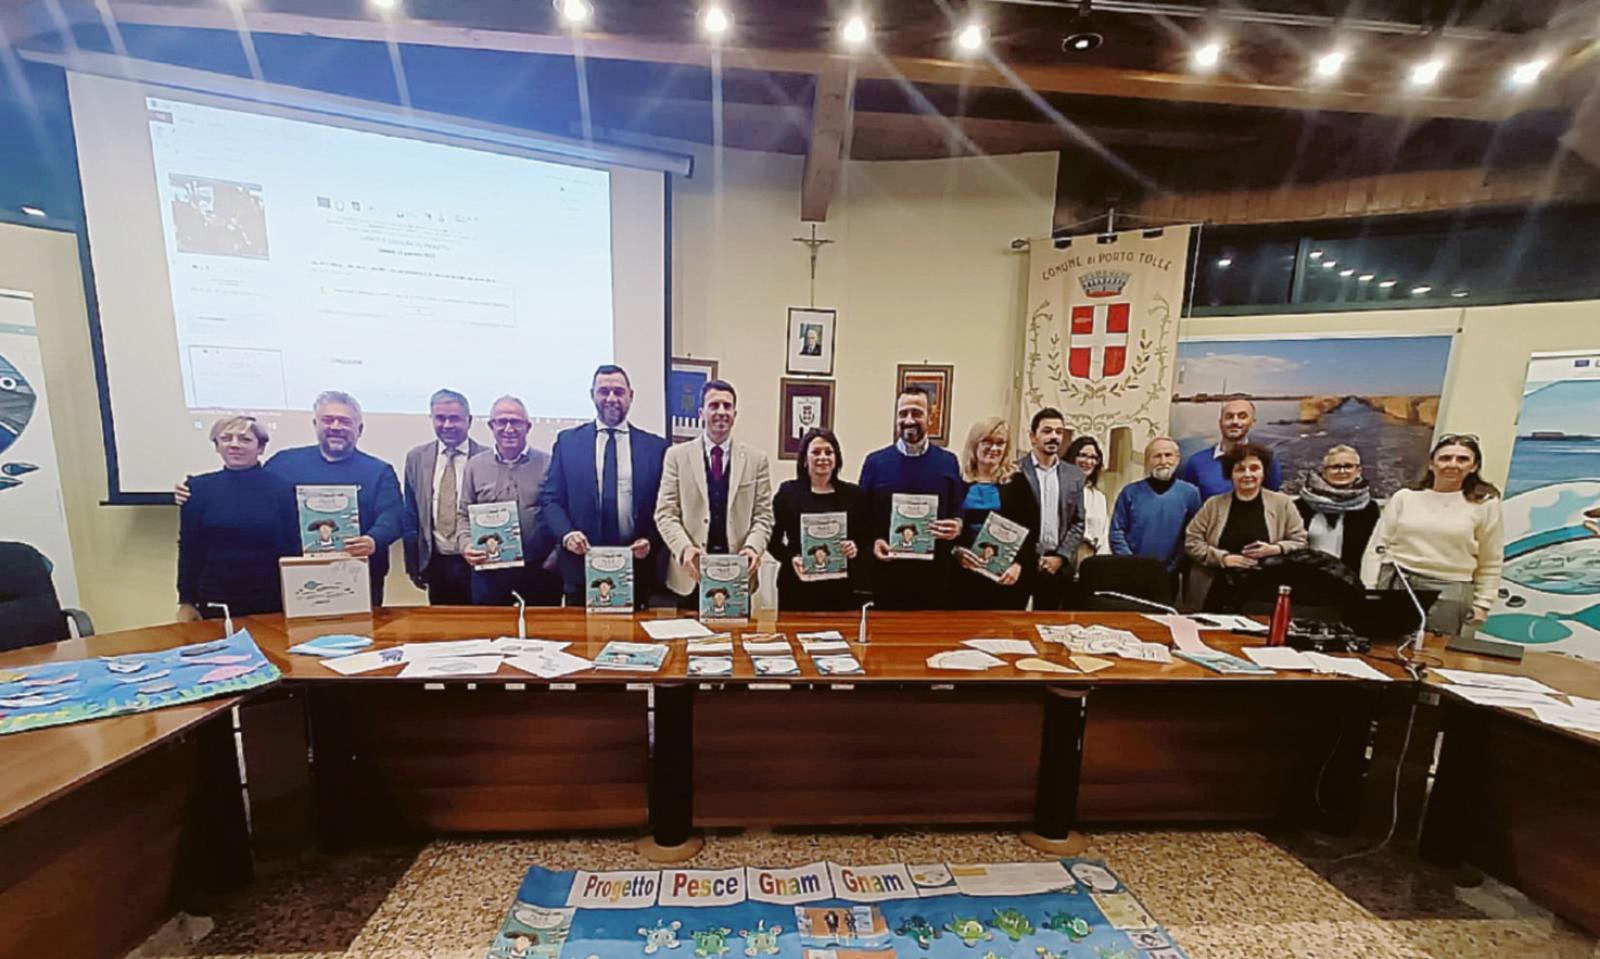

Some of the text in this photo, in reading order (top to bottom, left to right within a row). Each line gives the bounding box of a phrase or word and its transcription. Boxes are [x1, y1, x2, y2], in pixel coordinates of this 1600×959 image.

[1042, 256, 1082, 280] COMUNE
[1098, 251, 1134, 263] PORTO
[1139, 252, 1172, 271] TOLLE
[583, 869, 905, 902] Progetto Pesce Gnam Gnam
